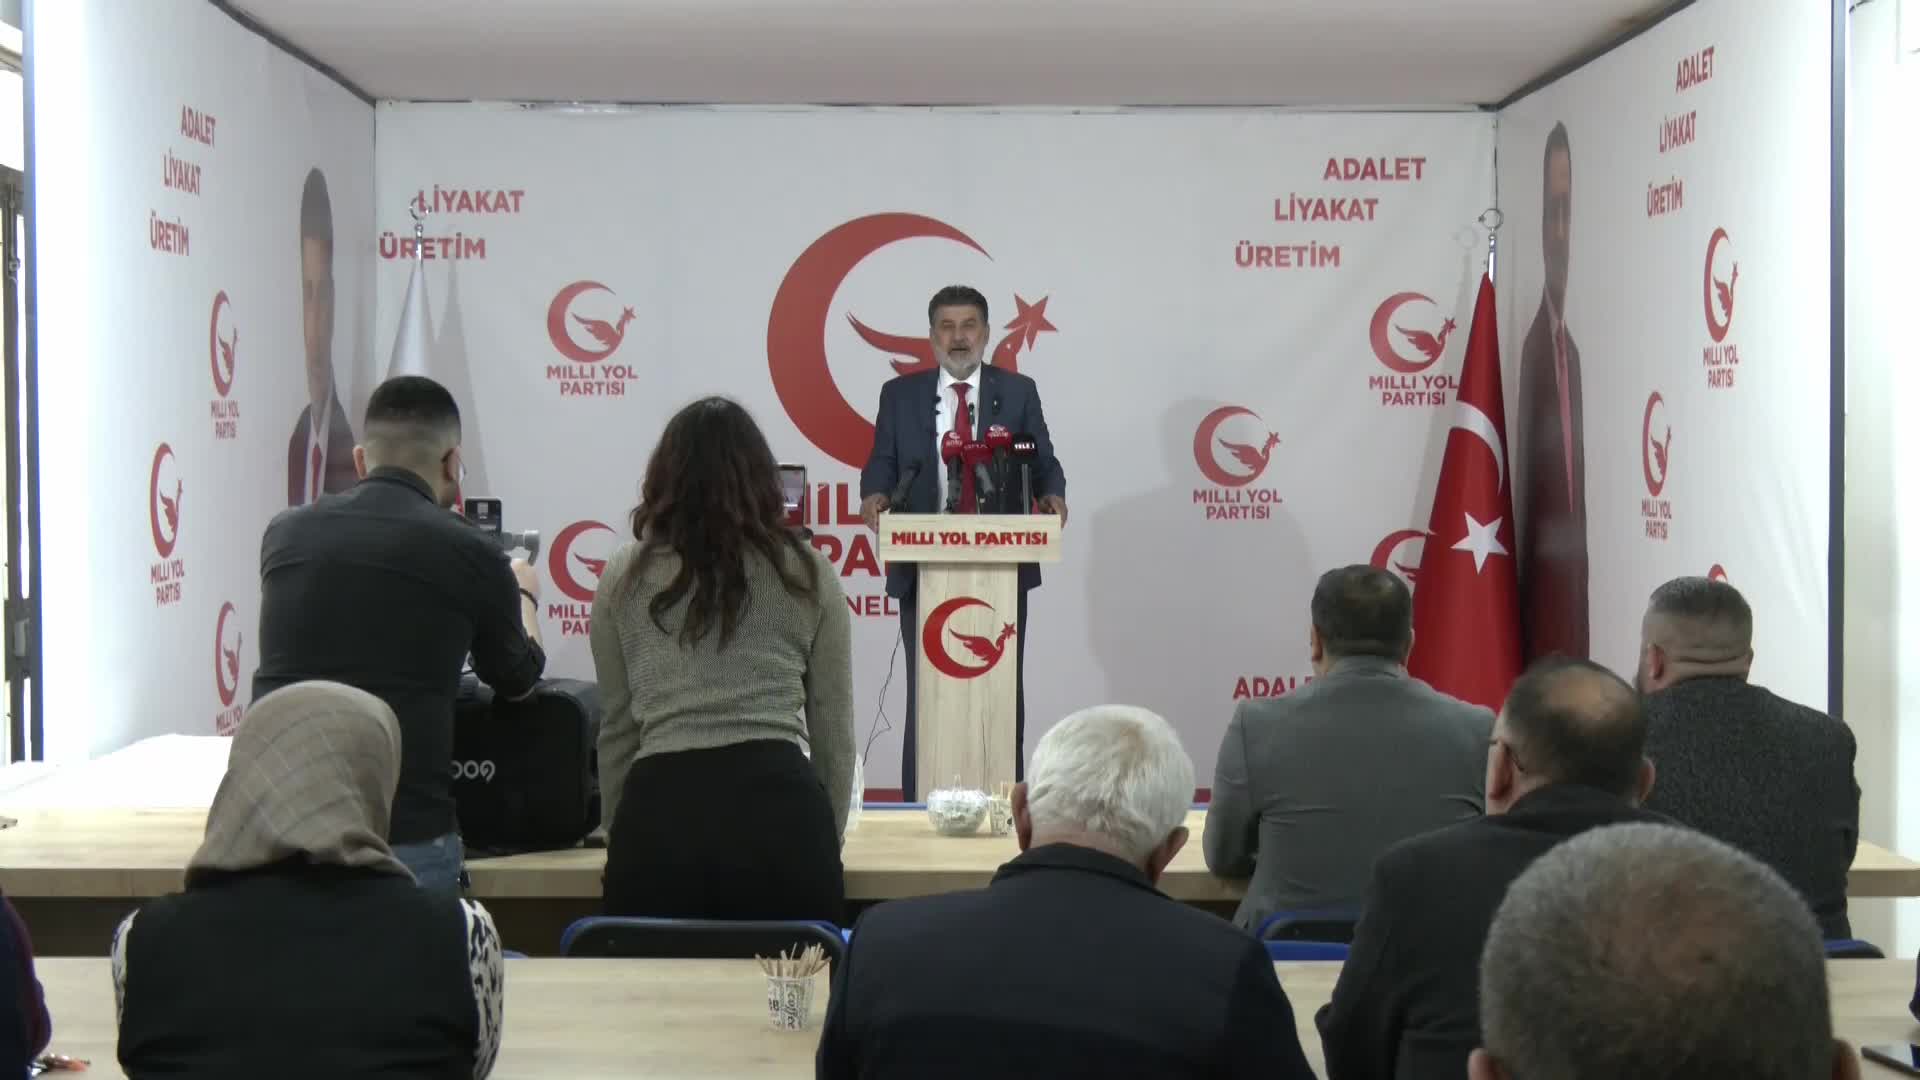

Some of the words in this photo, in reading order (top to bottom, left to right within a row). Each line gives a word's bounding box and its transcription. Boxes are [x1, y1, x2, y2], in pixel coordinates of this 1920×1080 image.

[1675, 45, 1714, 92] ADALET
[181, 104, 216, 148] ADALET
[1659, 110, 1696, 153] LİYAKAT
[163, 148, 201, 195] LİYAKAT
[1323, 157, 1426, 181] ADALET
[418, 184, 525, 213] LİYAKAT
[1274, 193, 1379, 221] LİYAKAT
[1647, 175, 1683, 217] ÜRETİM
[150, 210, 189, 256] ÜRETİM
[1235, 241, 1341, 267] ÜRETİM
[1723, 344, 1739, 364] YOL
[601, 365, 638, 379] YOL
[1422, 376, 1458, 390] YOL
[1247, 489, 1283, 503] YOL
[939, 532, 970, 545] YOL
[549, 604, 590, 618] MILL
[847, 596, 898, 616] NEL
